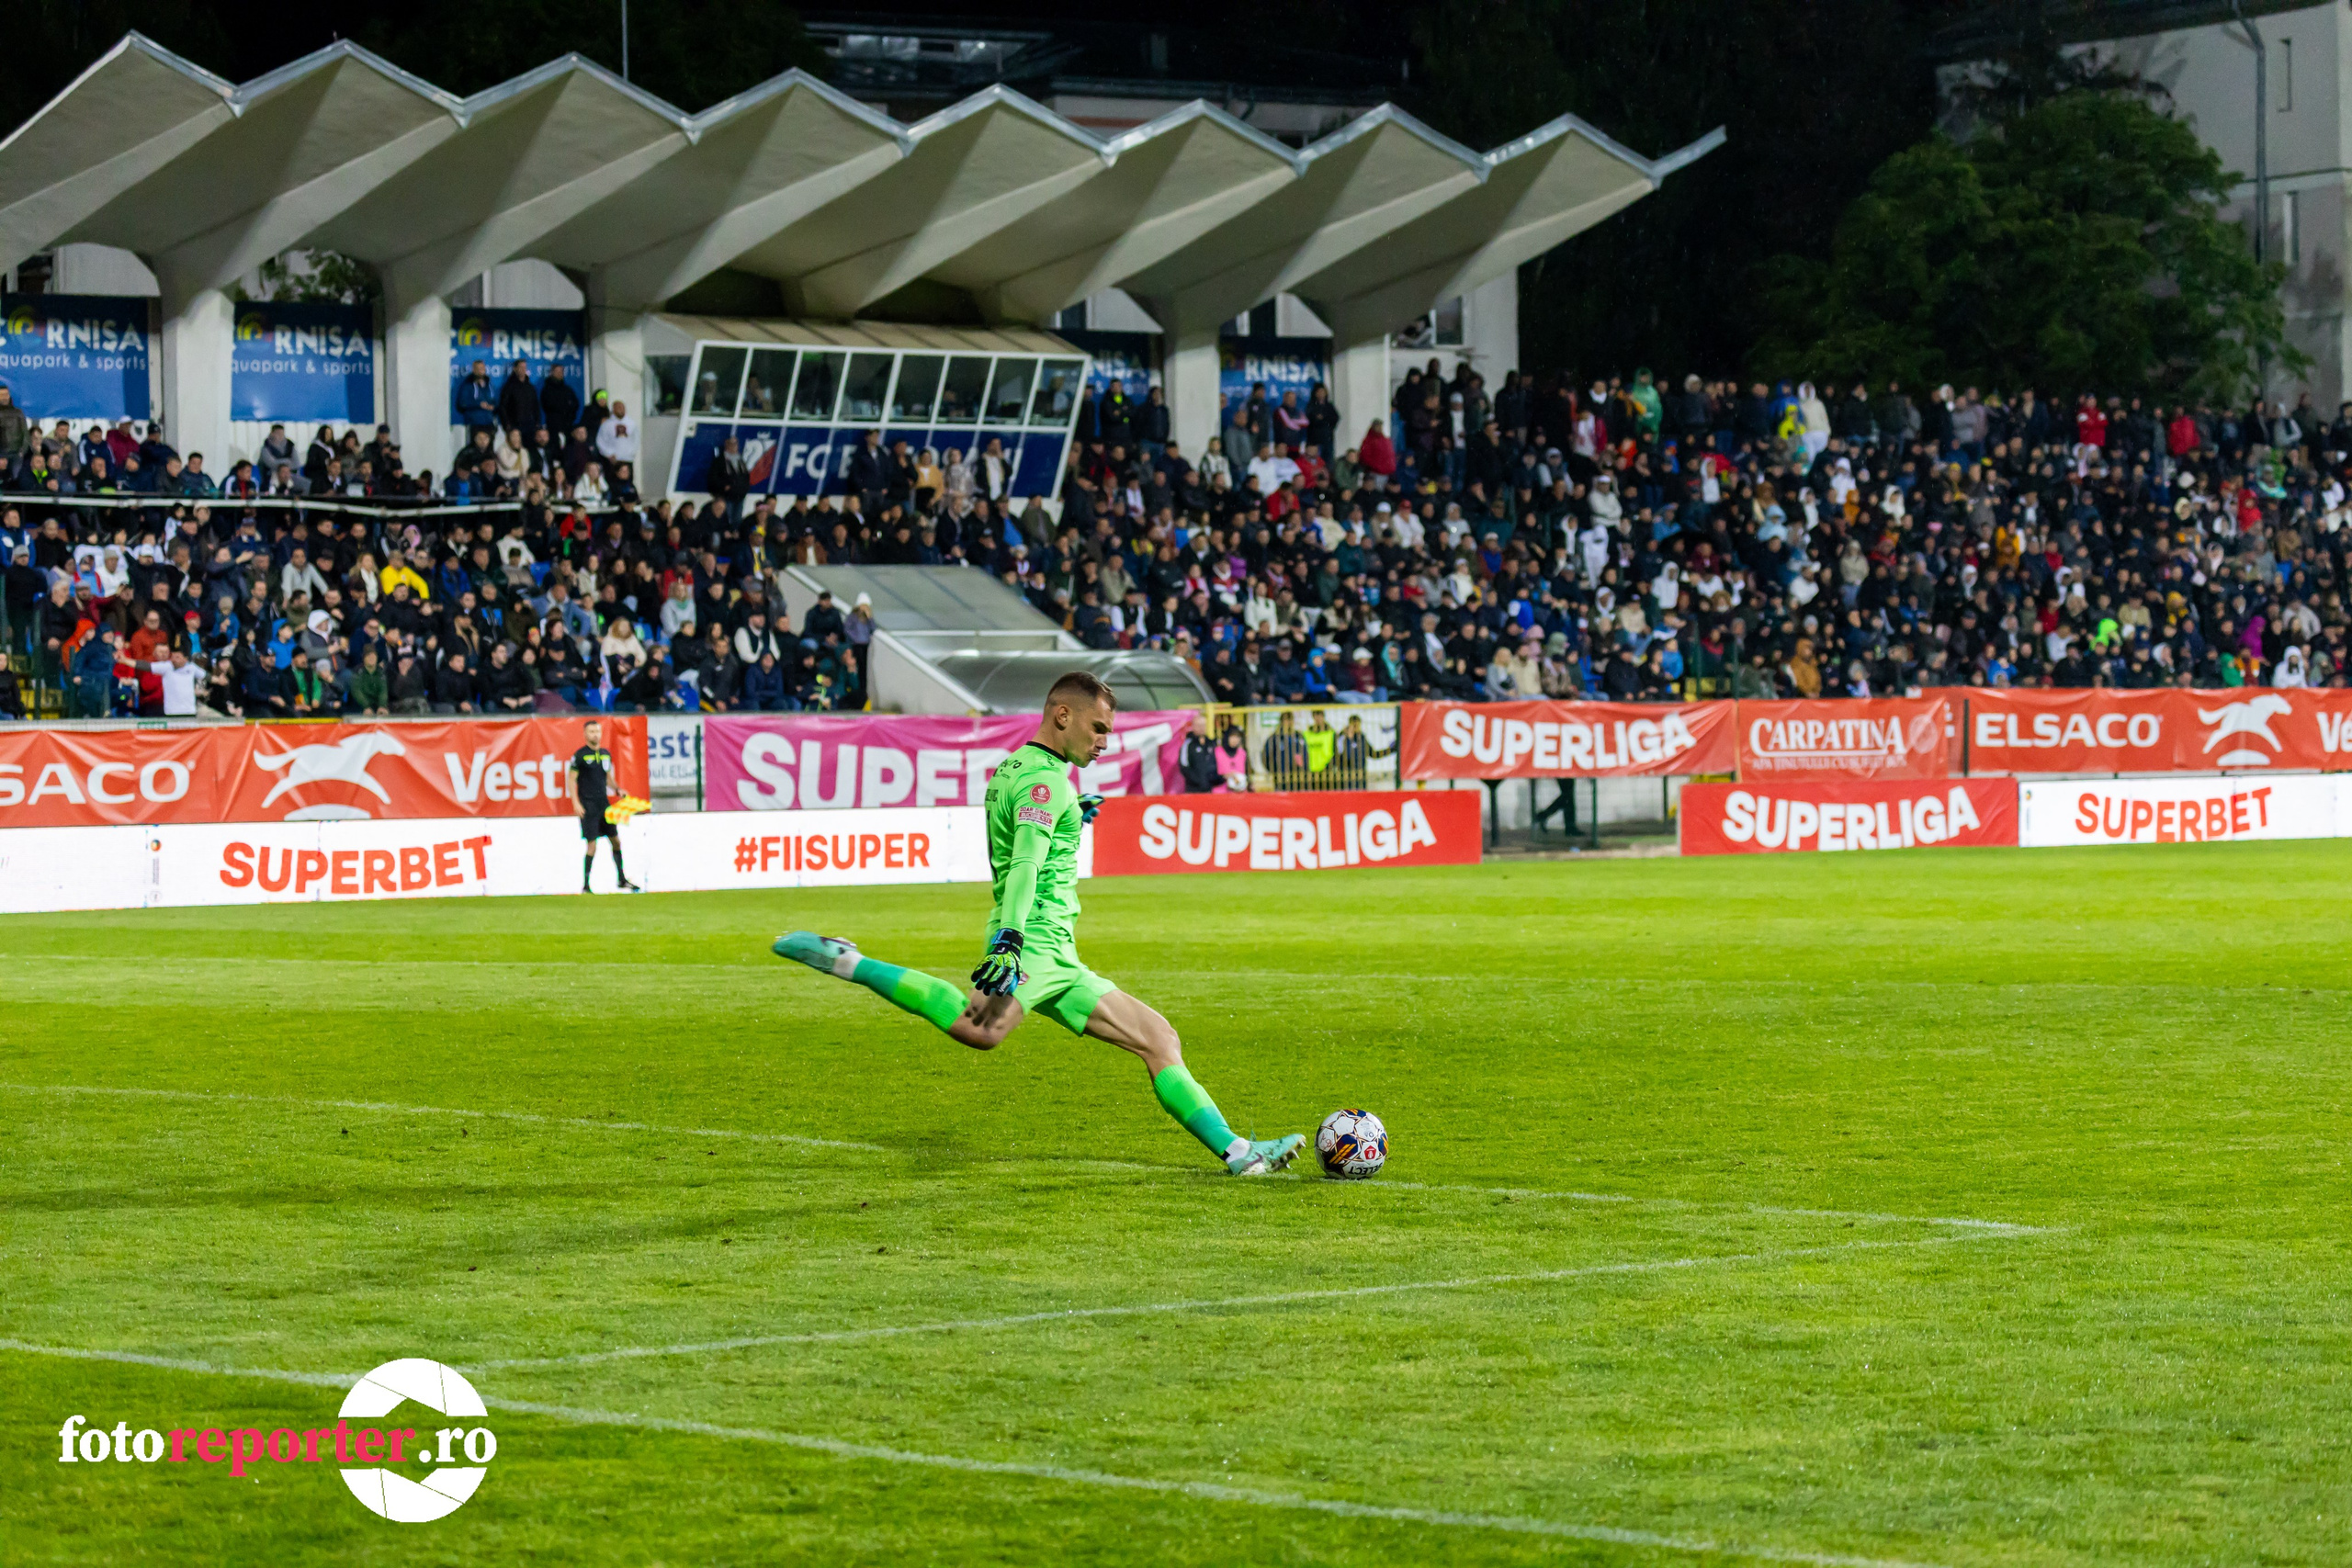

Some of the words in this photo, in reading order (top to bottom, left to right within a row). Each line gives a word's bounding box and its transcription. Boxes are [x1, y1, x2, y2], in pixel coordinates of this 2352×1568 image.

[1440, 709, 1696, 770] SUPERLIGA
[1749, 716, 1907, 757] CARPATINA
[1976, 713, 2160, 748] ELSACO
[737, 723, 1173, 810] SUPEET
[1139, 799, 1437, 870] SUPERLIGA
[1723, 786, 1981, 852] SUPERLIGA
[2075, 787, 2272, 843] SUPERBET
[220, 835, 492, 895] SUPERBET
[734, 832, 930, 873] #FIISUPER
